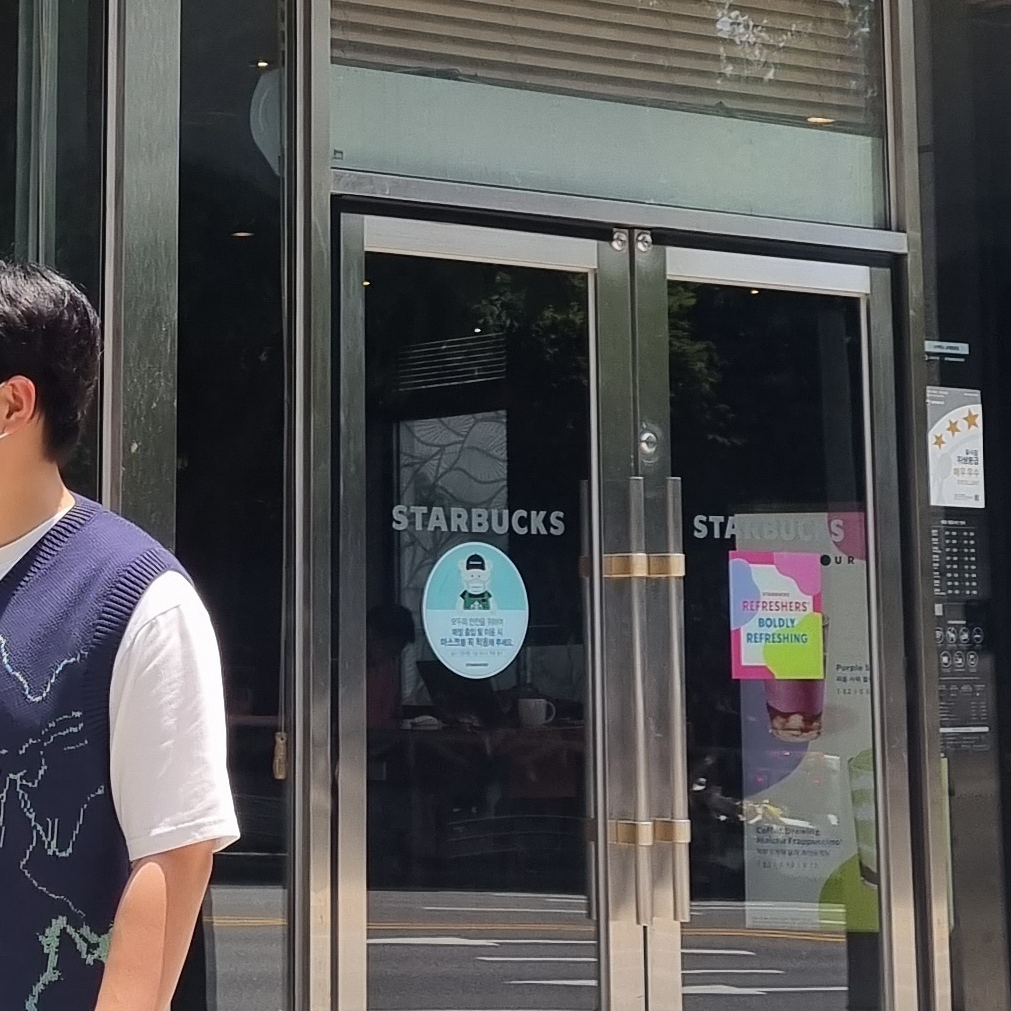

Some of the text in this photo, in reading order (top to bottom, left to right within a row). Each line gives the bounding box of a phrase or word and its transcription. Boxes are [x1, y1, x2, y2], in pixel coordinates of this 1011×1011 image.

[391, 504, 566, 536] STARBUCKS
[742, 600, 808, 612] REFRESHERS
[758, 617, 796, 628] BOLDLY
[746, 632, 808, 644] REFRESHING
